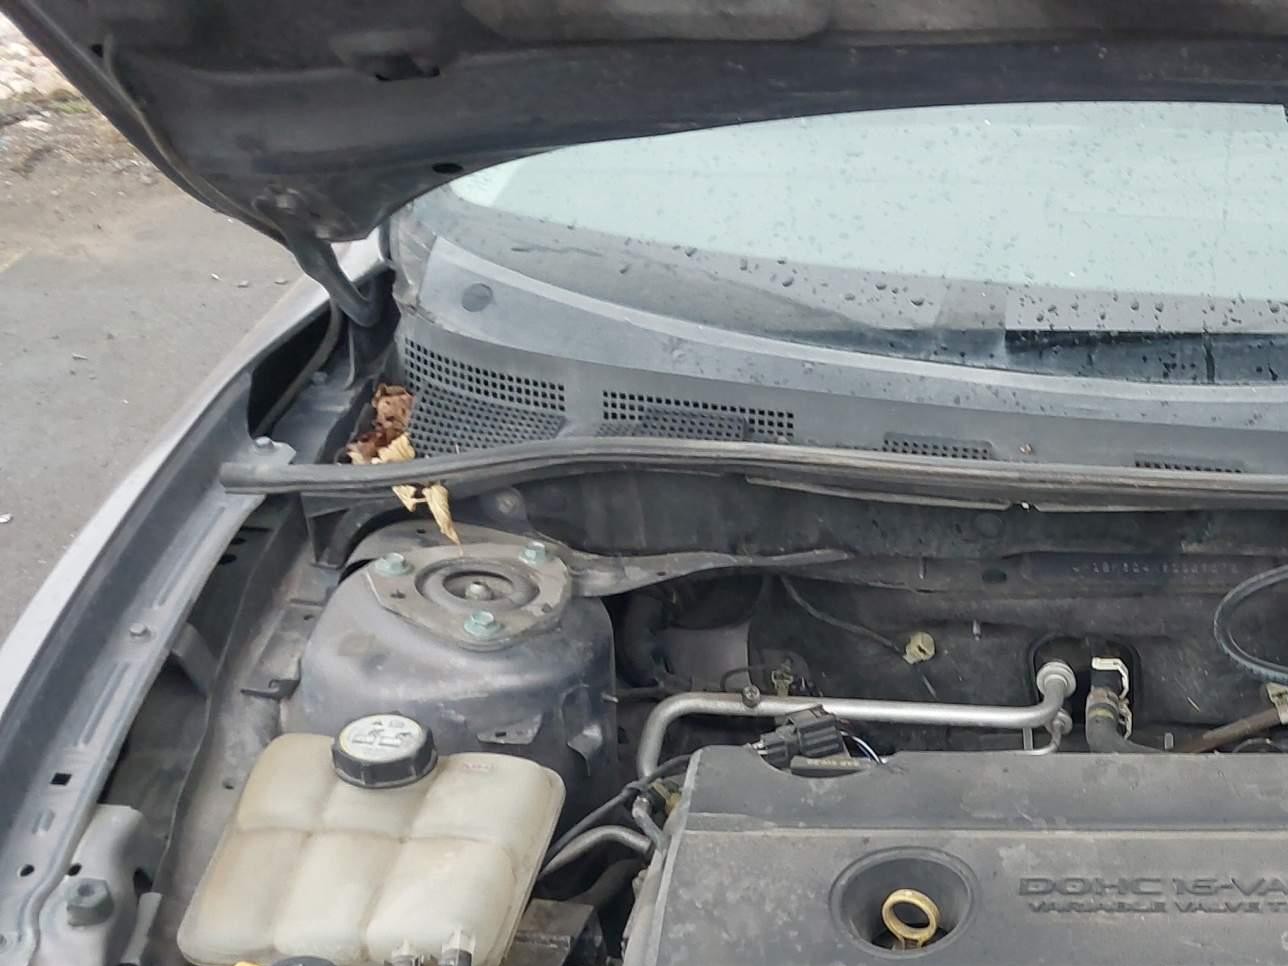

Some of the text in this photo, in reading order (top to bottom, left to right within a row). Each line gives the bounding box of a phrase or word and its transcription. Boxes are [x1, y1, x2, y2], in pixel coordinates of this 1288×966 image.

[1018, 877, 1163, 896] DOHC
[1027, 901, 1168, 913] VARIABLE
[1173, 901, 1261, 913] VALVE
